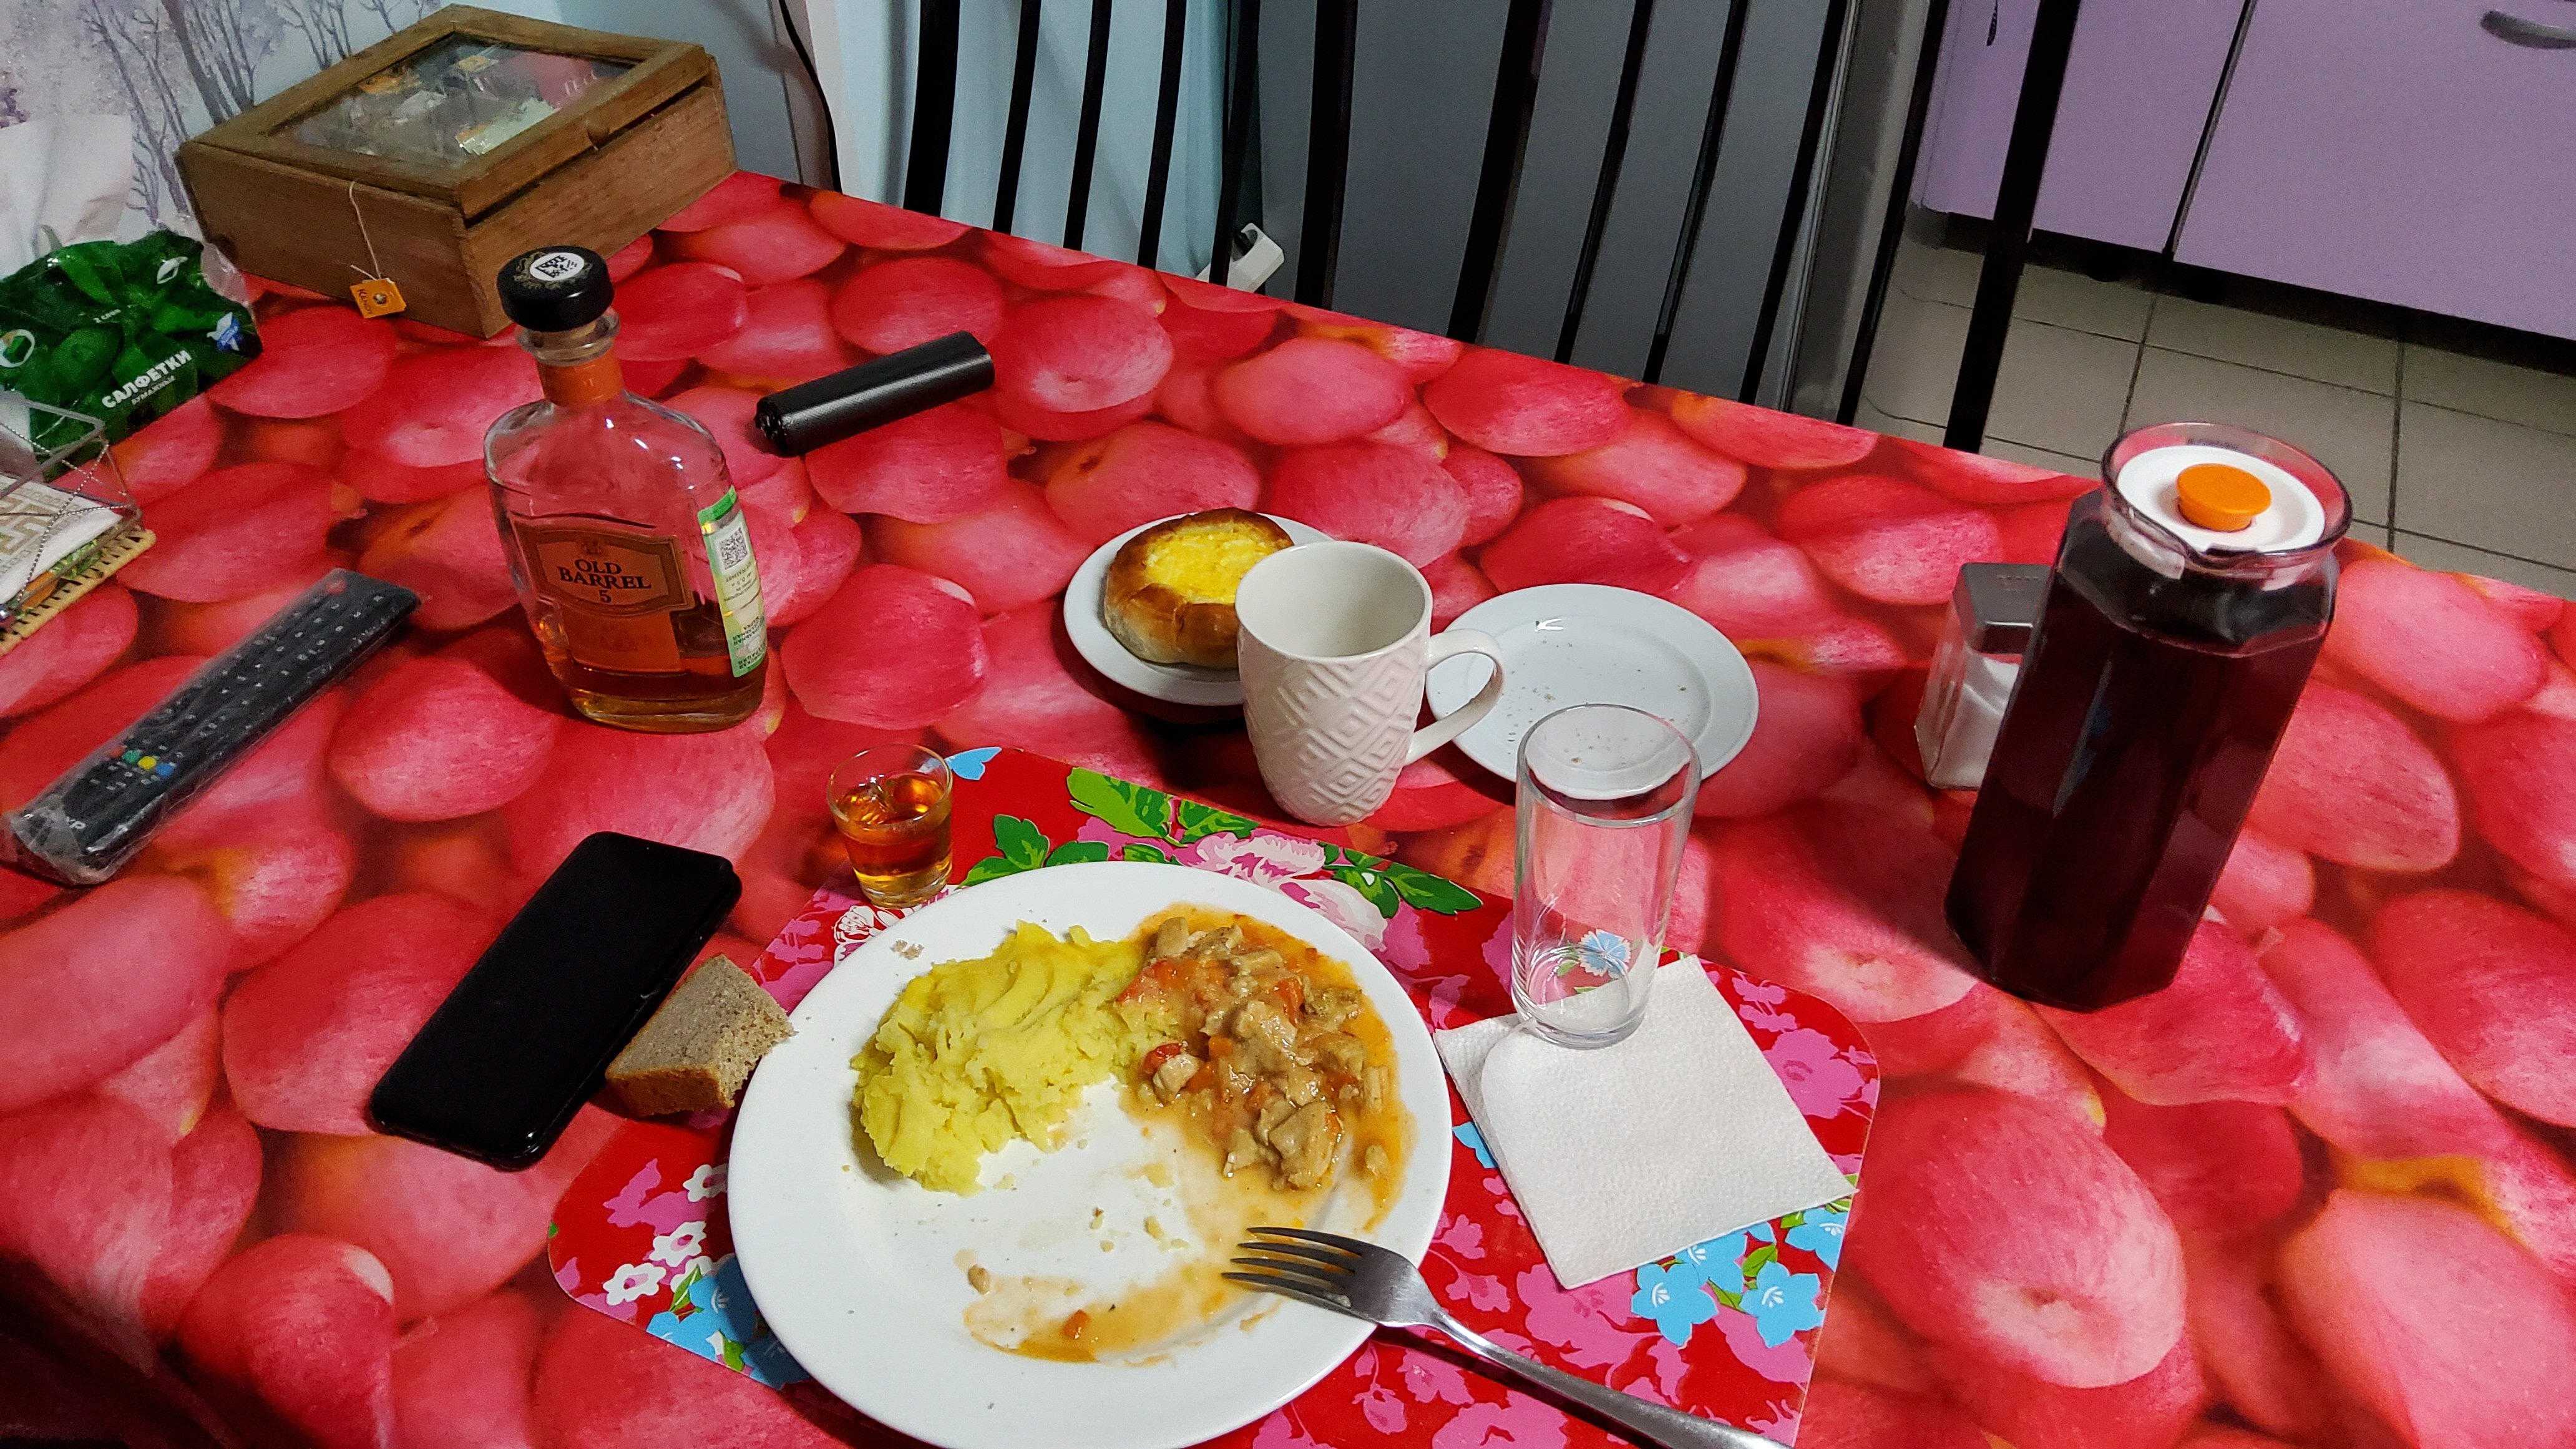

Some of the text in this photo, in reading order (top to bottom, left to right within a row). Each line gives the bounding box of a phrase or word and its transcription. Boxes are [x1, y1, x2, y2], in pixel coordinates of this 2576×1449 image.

[101, 349, 193, 408] САЛФЕТКИ
[574, 559, 622, 575] OLD
[556, 566, 652, 590] BARREL
[598, 589, 612, 603] 5
